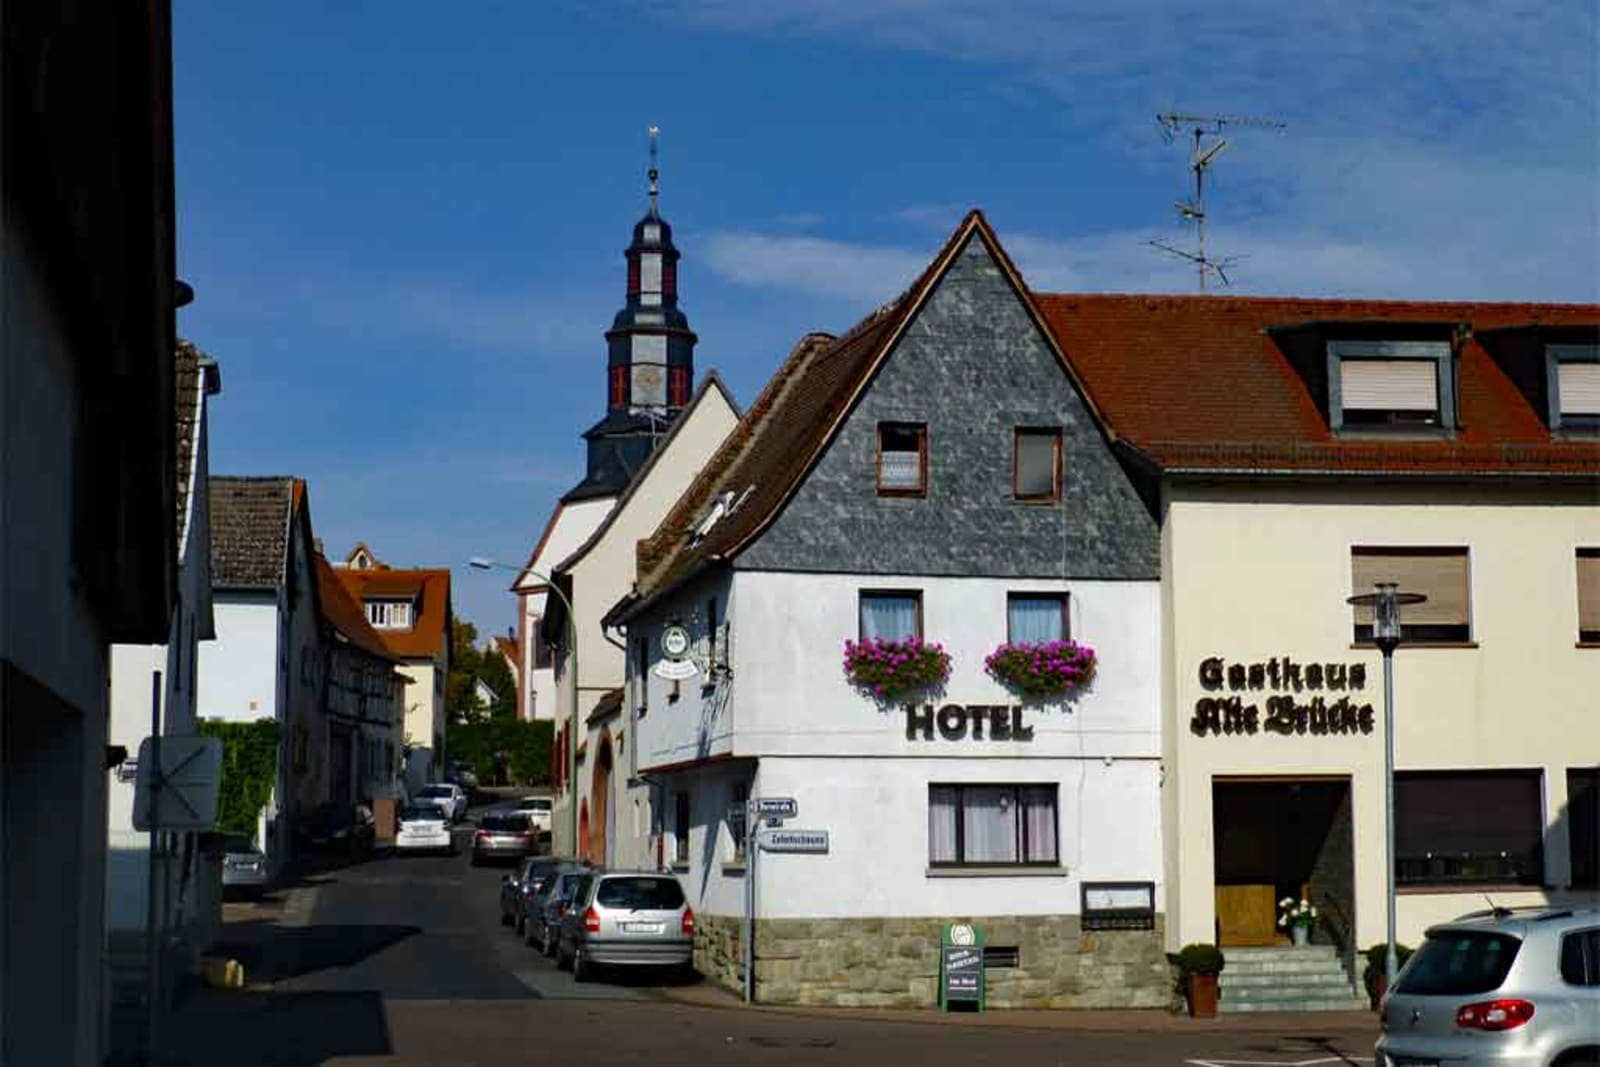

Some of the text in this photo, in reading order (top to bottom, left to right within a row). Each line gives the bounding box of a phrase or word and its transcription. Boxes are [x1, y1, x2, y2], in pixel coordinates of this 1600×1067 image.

[1199, 656, 1366, 693] Gasthaus
[906, 703, 1034, 741] HOTEL
[1190, 695, 1375, 737] Alte Brücke
